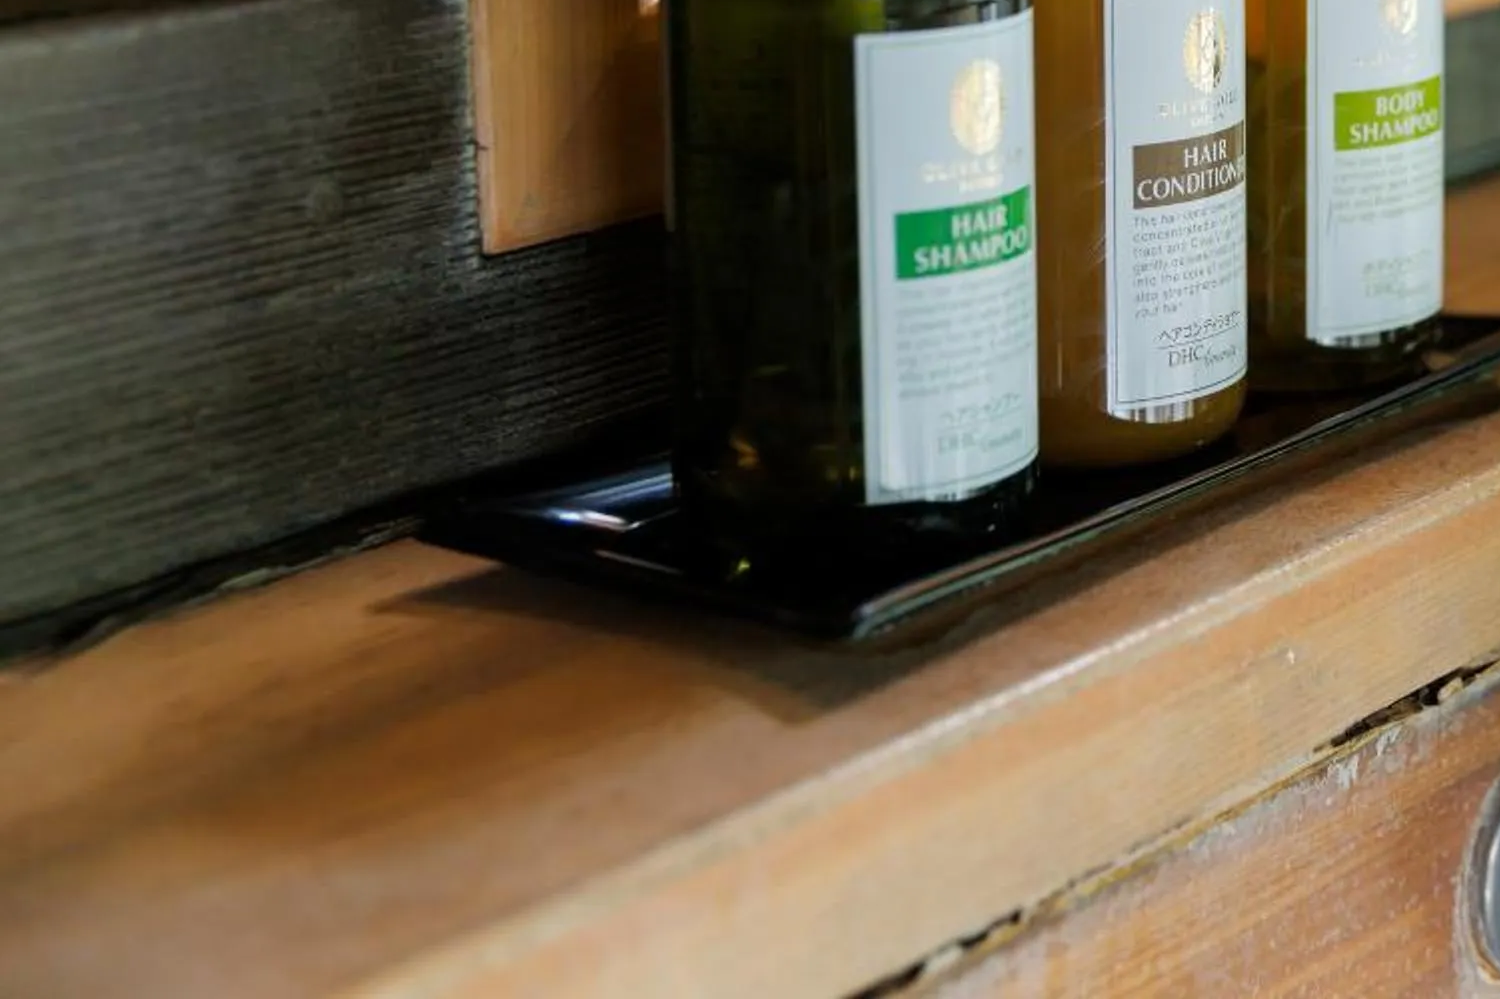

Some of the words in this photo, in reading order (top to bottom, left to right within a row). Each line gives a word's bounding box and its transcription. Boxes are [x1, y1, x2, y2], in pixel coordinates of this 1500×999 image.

[1376, 90, 1425, 117] BODY
[1349, 108, 1438, 144] SHAMPOO
[1184, 139, 1227, 168] HAIR
[951, 204, 1008, 240] HAIR
[914, 225, 1027, 274] SHAMPOO
[1168, 344, 1205, 368] DHC
